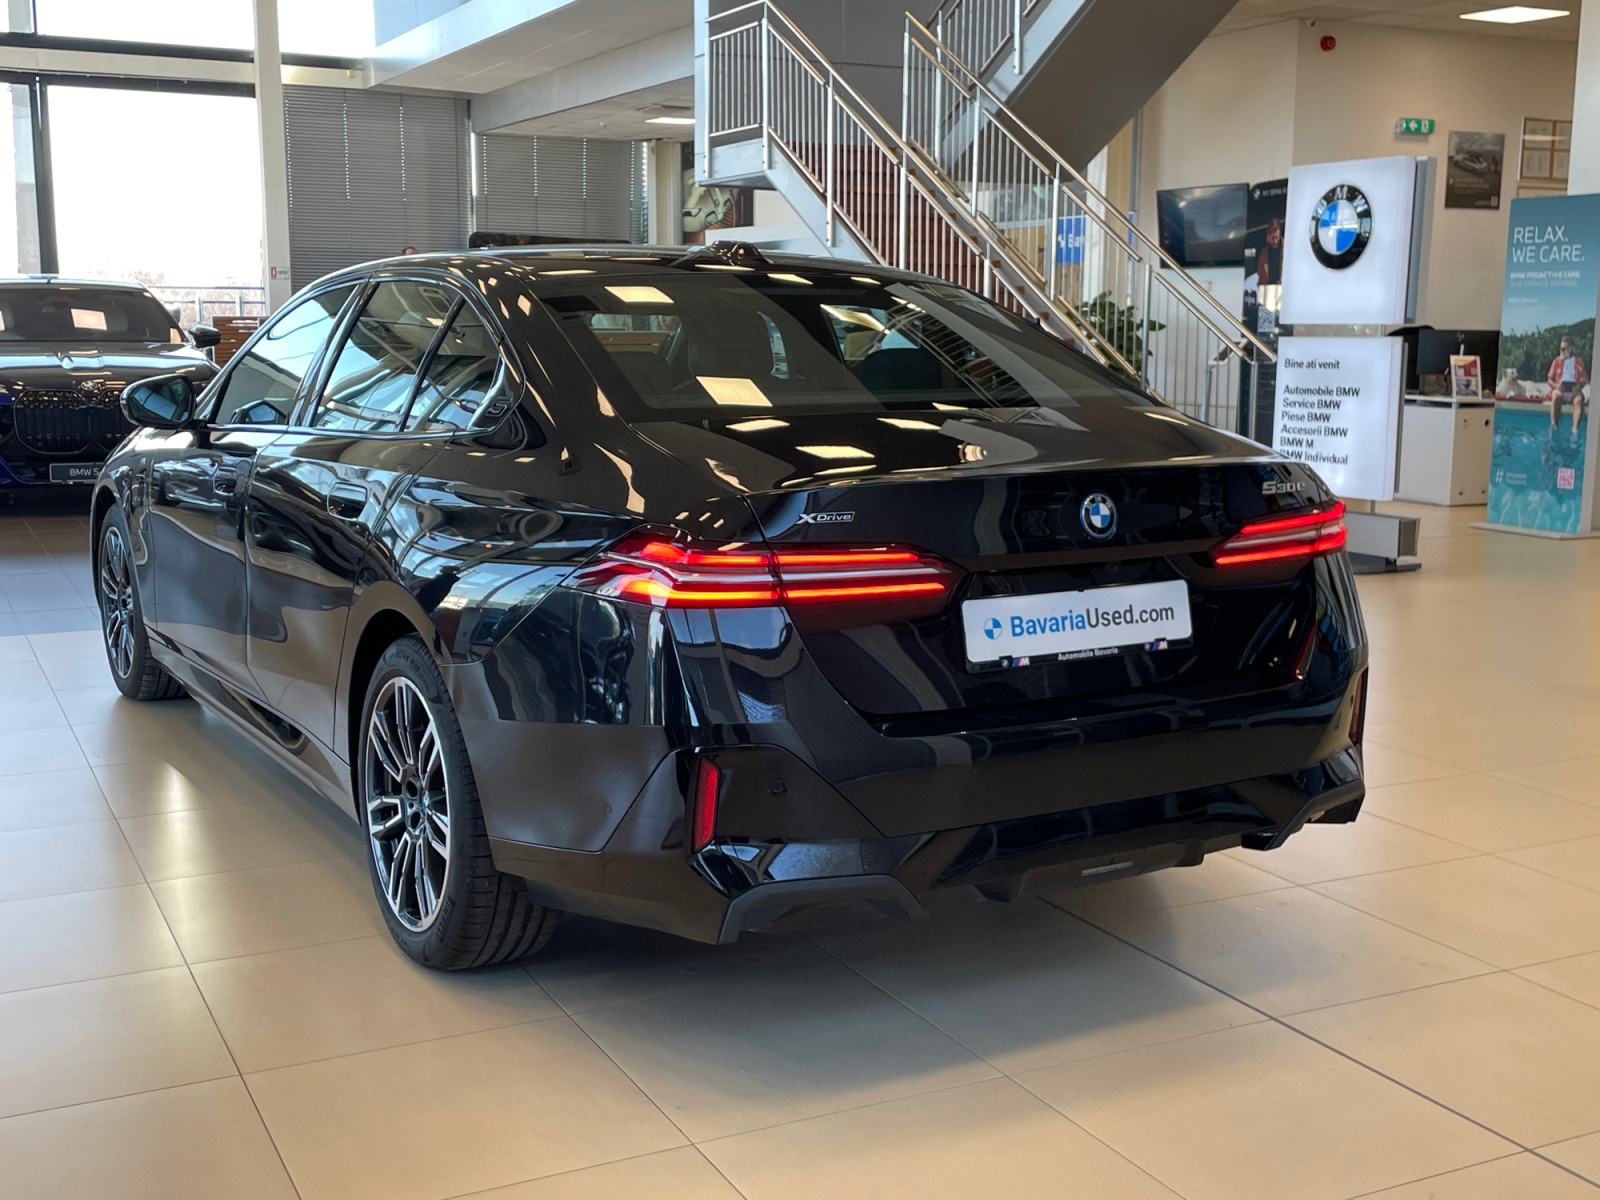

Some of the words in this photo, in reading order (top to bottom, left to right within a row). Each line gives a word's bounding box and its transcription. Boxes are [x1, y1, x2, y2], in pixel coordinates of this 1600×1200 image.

[1312, 185, 1368, 218] BMW
[1513, 225, 1568, 244] RELAX.
[1512, 246, 1536, 263] WE
[1540, 244, 1585, 263] CARE.
[1527, 271, 1562, 279] PROACTIVE
[1284, 358, 1304, 369] Bine
[1305, 359, 1317, 369] ati
[1318, 359, 1340, 369] venit
[1283, 385, 1334, 396] Automobile
[1336, 387, 1360, 397] BMW
[1282, 398, 1315, 409] Service
[1317, 399, 1341, 410] BMW
[1281, 411, 1305, 421] Piese
[1307, 412, 1331, 423] BMW
[1280, 424, 1322, 436] Accesorii
[1324, 427, 1348, 438] BMW
[1280, 437, 1304, 447] BMW
[1305, 438, 1314, 448] M
[1305, 452, 1348, 465] Individual
[1010, 604, 1175, 637] BavariaUsed.com
[1057, 649, 1094, 660] Automobile
[1095, 647, 1119, 657] Bavaria
